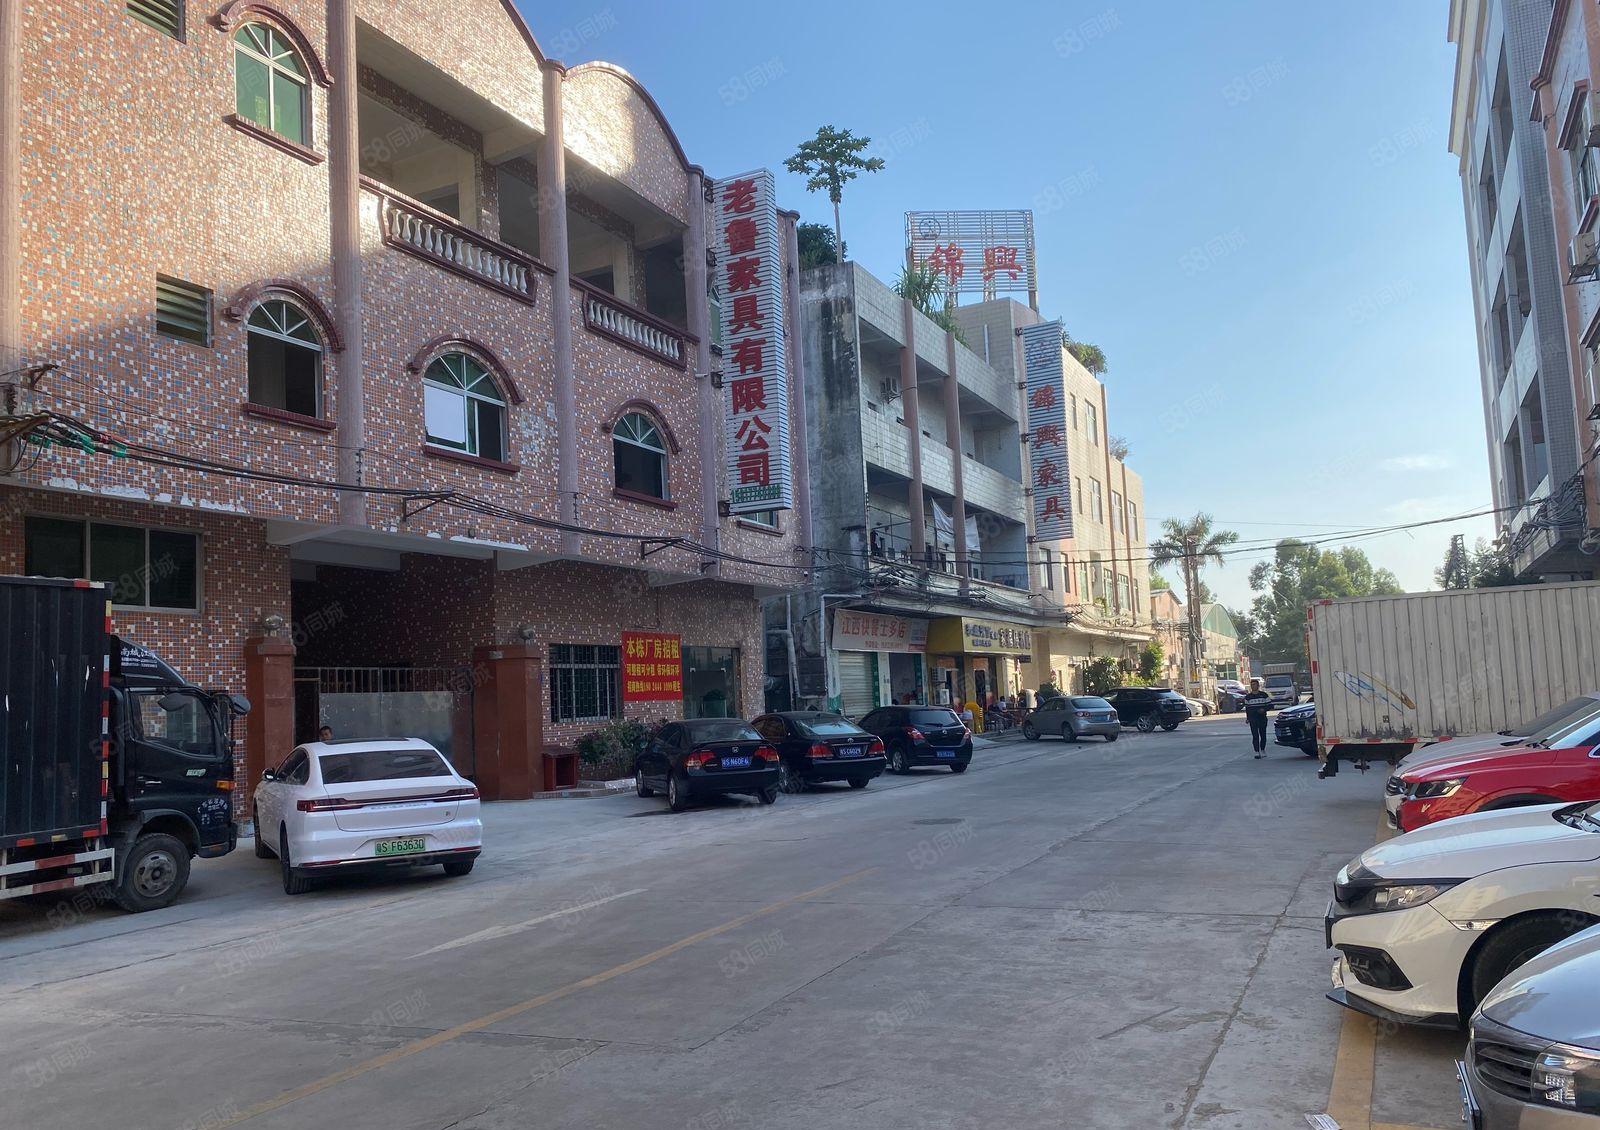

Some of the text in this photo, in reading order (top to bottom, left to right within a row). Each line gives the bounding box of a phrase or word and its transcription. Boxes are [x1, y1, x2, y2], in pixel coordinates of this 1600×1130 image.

[626, 637, 680, 659] 本栋厂房招租
